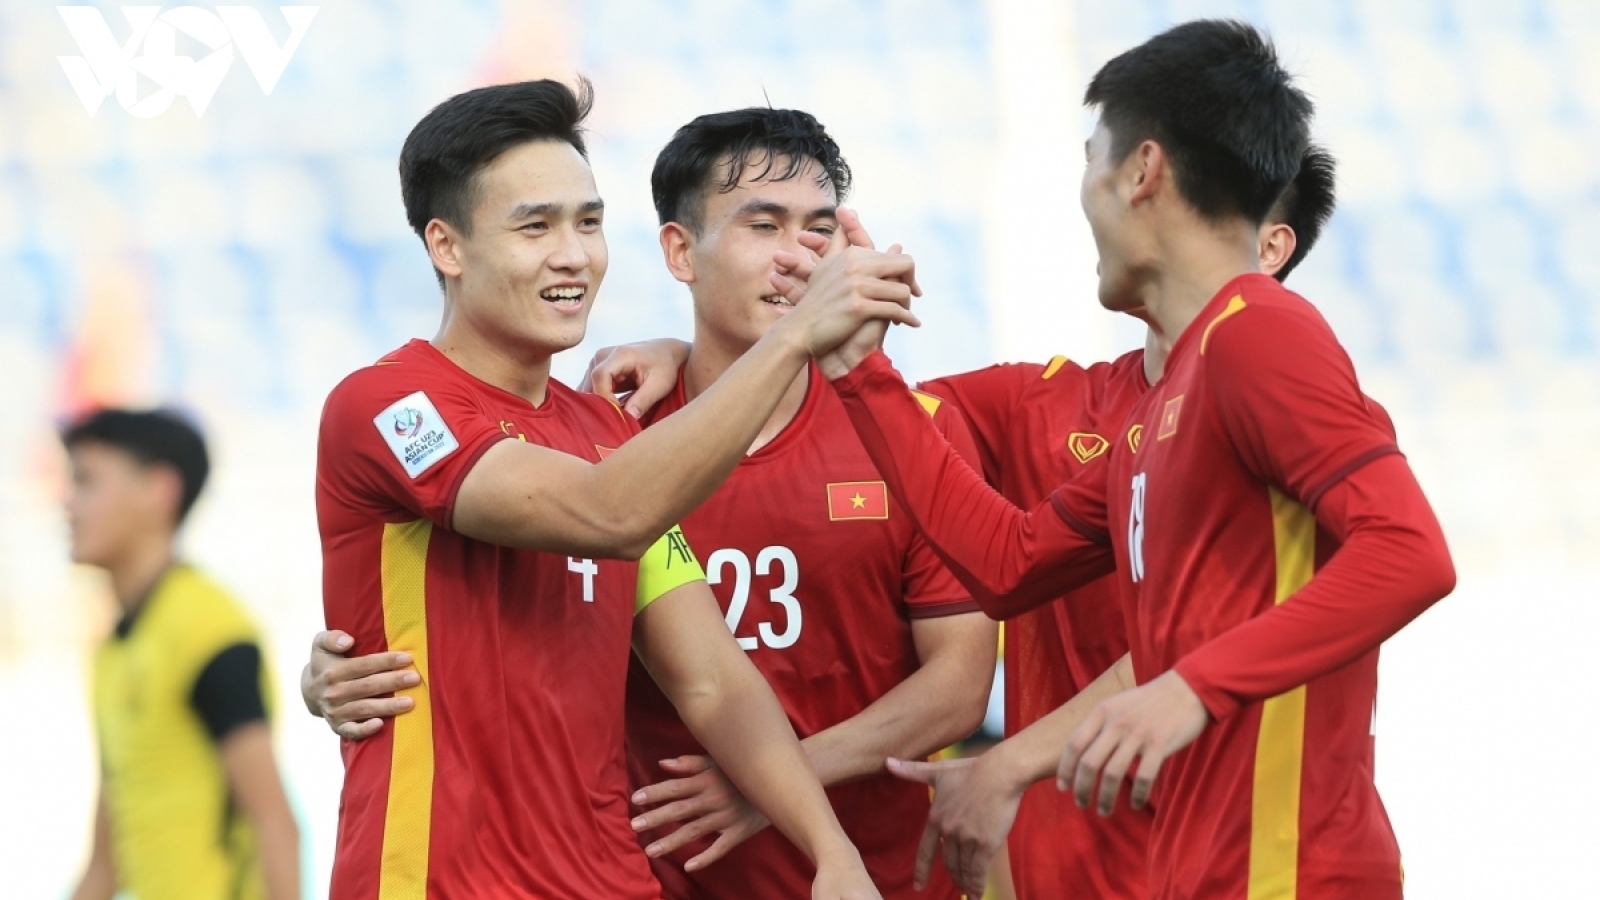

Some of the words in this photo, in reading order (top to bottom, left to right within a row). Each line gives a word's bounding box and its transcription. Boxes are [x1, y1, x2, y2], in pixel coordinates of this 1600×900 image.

[405, 440, 420, 454] AFC
[420, 430, 436, 442] U23
[405, 443, 428, 463] ASIAN
[428, 433, 444, 446] CUP
[707, 546, 802, 650] 23
